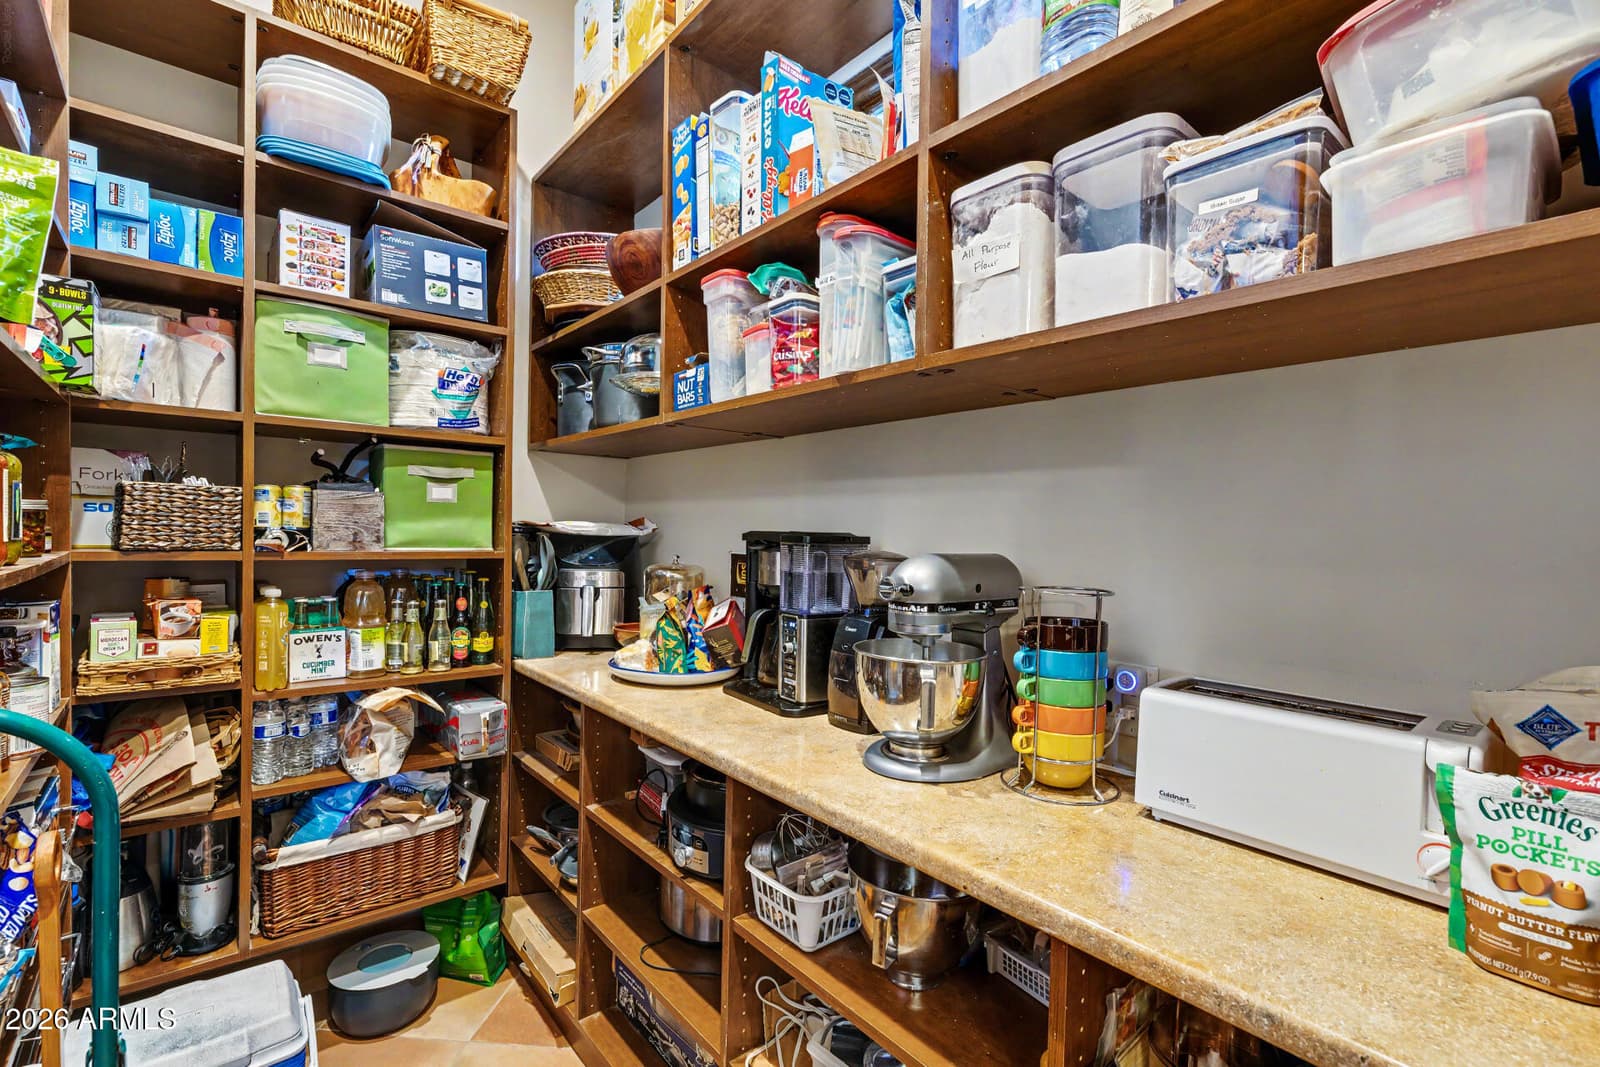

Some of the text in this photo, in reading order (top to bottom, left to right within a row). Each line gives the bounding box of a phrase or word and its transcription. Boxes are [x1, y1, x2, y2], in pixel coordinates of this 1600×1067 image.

[71, 200, 87, 235] Ziploc
[156, 213, 175, 245] Ziploc
[219, 232, 237, 264] Ziploc
[962, 241, 1011, 261] All Purpose
[974, 259, 999, 273] Flour
[60, 287, 87, 300] BOWLS
[773, 349, 812, 362] aisins
[677, 378, 696, 394] NUT
[677, 391, 696, 405] BARS
[83, 502, 114, 513] SO
[293, 634, 343, 646] OWEN'S
[302, 659, 336, 670] CUCUMBER
[310, 666, 328, 675] MINT
[1159, 789, 1190, 804] Cuisinart
[1478, 796, 1599, 842] Greenies
[1511, 825, 1569, 853] PILL
[1476, 833, 1600, 877] POCKETS
[1507, 911, 1566, 937] BUTTER
